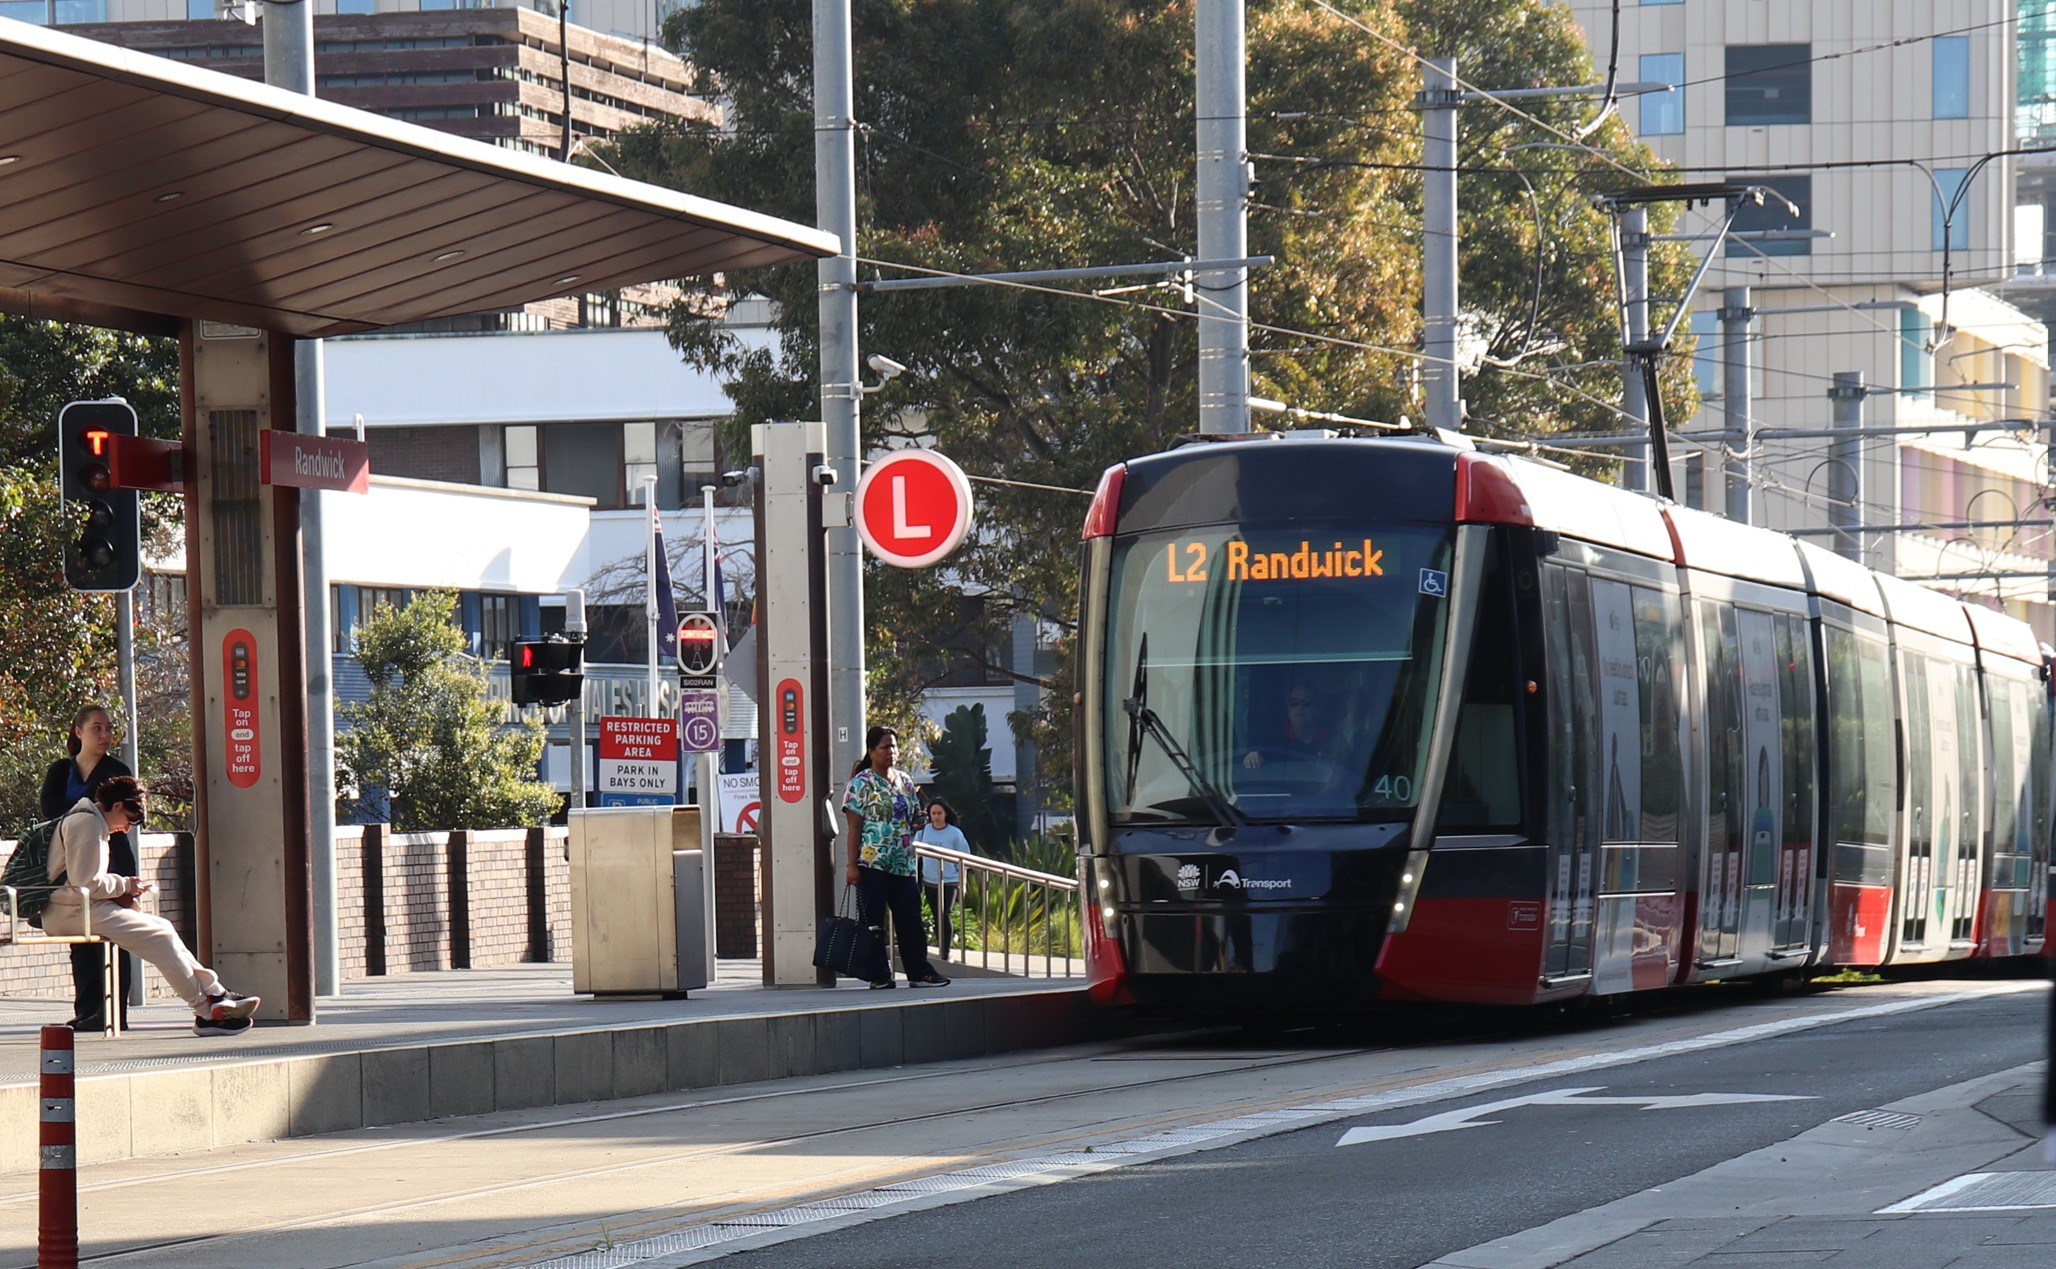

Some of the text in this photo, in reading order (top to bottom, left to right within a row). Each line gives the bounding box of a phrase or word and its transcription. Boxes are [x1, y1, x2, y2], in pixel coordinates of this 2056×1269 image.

[87, 431, 108, 456] T
[295, 446, 346, 480] Randwick
[892, 475, 932, 540] L
[1167, 538, 1384, 583] L2 Randwick
[232, 708, 251, 719] Tap
[606, 721, 671, 734] RESTRICTED
[693, 725, 708, 740] 15
[615, 734, 662, 746] PARKING
[839, 729, 847, 740] H
[234, 744, 251, 753] tap
[783, 740, 798, 750] Tap
[624, 747, 652, 758] AREA
[236, 754, 250, 763] off
[232, 764, 255, 773] here
[617, 765, 659, 776] PARK IN
[784, 768, 798, 776] tap
[609, 777, 666, 788] BAYS ONLY
[723, 778, 738, 788] NO
[785, 776, 797, 784] off
[1374, 774, 1411, 801] 40
[1178, 878, 1201, 888] NSW
[1241, 878, 1292, 890] Transport
